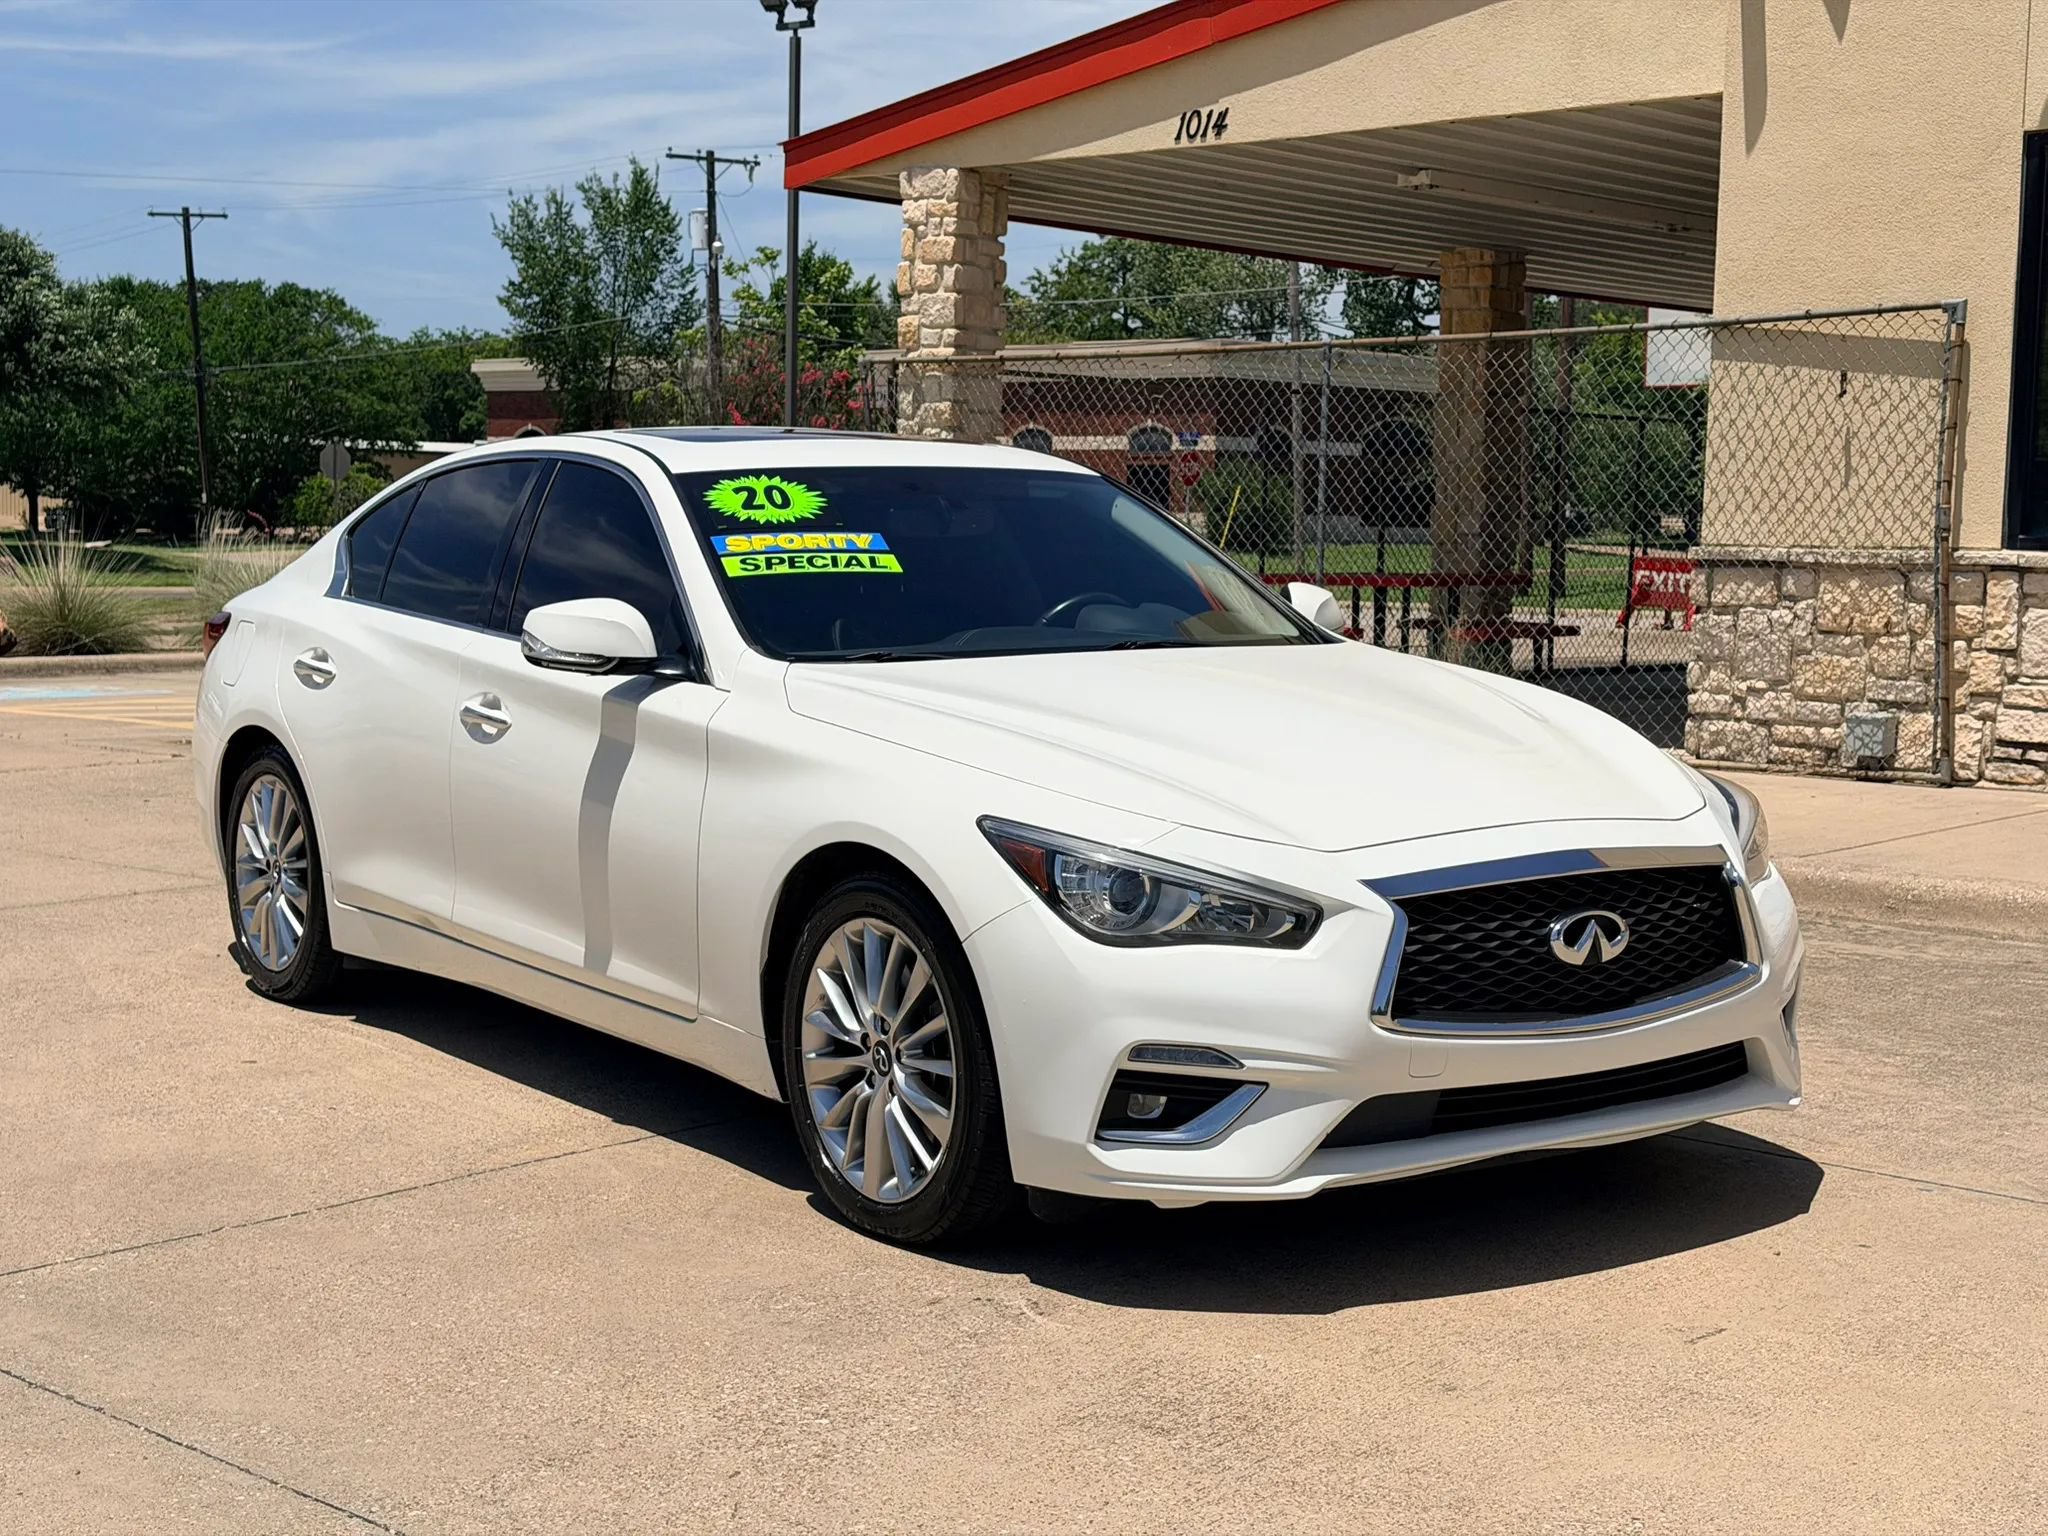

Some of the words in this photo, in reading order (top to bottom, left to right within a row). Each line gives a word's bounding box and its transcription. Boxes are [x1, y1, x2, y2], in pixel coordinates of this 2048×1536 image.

[1174, 107, 1229, 142] 1014
[732, 485, 792, 511] 20
[724, 533, 873, 552] SPORTY
[739, 555, 890, 572] SPECIAL
[1635, 569, 1691, 593] EXIT
